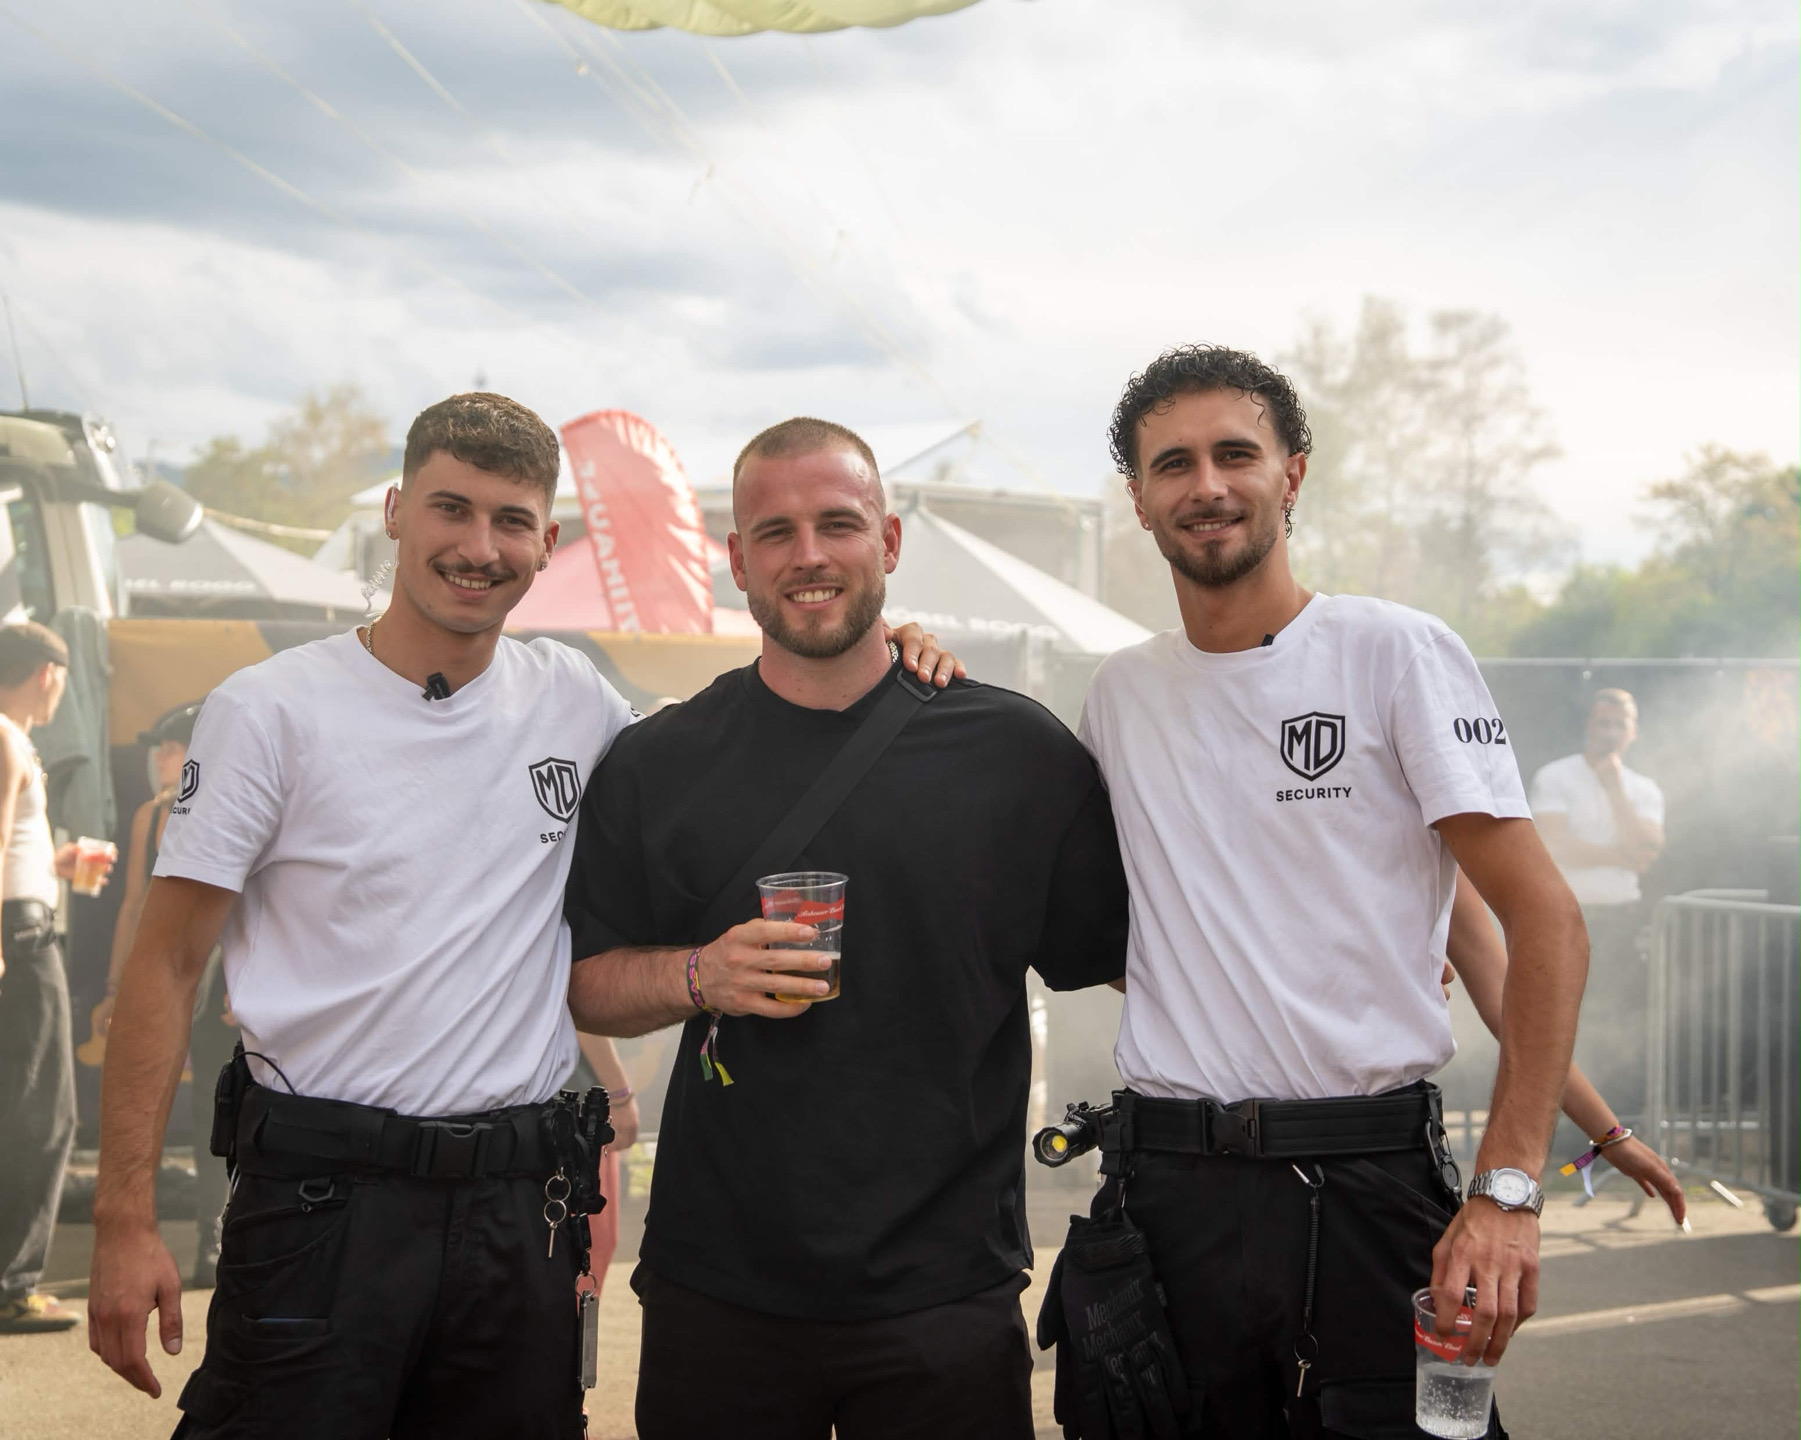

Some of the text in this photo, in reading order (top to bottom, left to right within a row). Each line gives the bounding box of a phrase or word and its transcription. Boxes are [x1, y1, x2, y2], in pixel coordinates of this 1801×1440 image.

[1288, 719, 1337, 772] MD
[1453, 717, 1506, 745] 002
[172, 806, 191, 815] CURI
[536, 764, 578, 815] MD
[1276, 786, 1352, 803] SECURITY
[1084, 1276, 1145, 1331] Mechanix
[1081, 1310, 1146, 1360] Mechanix
